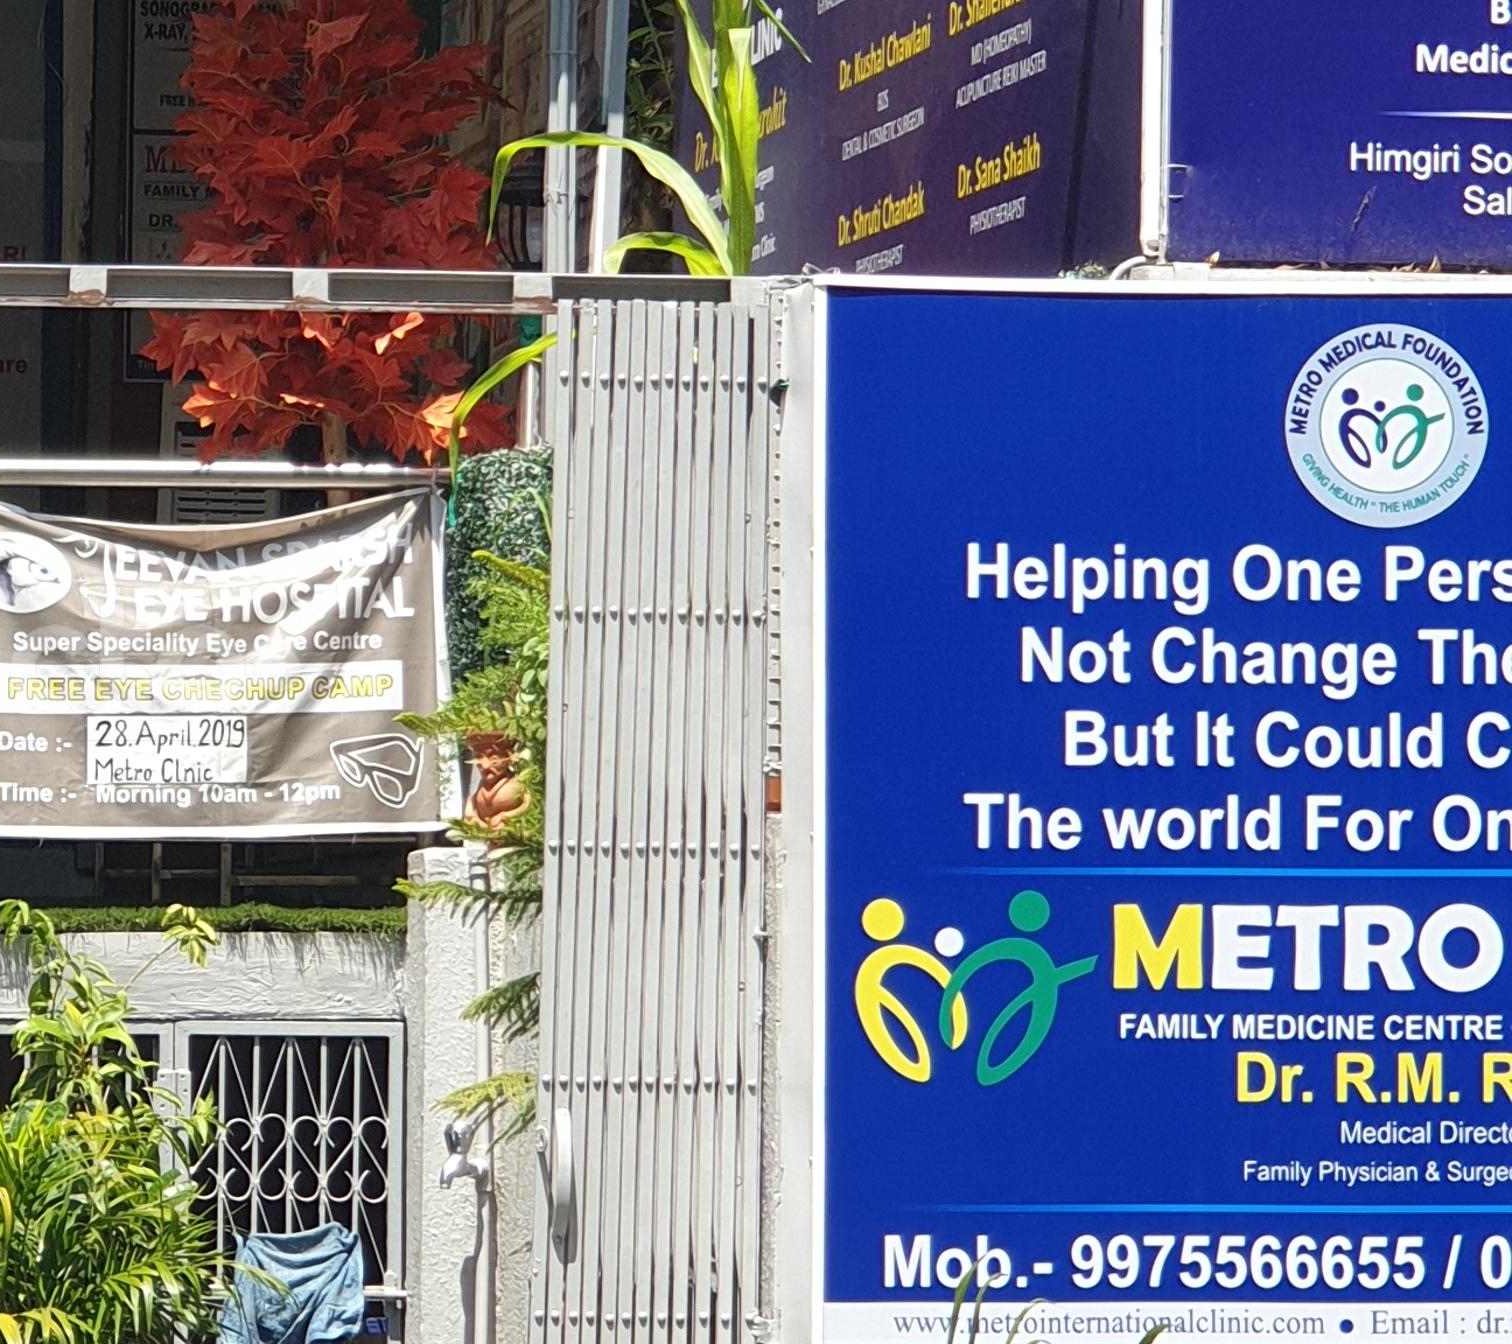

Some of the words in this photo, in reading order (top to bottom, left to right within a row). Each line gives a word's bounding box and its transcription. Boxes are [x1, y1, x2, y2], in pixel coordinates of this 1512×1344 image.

[1003, 132, 1041, 181] Shaikh
[1350, 141, 1460, 181] Himgiri
[1289, 370, 1323, 435] METRO
[1318, 331, 1398, 373] MEDICAL
[1401, 333, 1485, 436] FOUNDATION
[1302, 452, 1329, 487] GIVING
[1327, 478, 1369, 511] HEALTH
[1402, 485, 1442, 512] HUMAN
[967, 542, 1209, 616] Helping
[1232, 543, 1362, 602] One
[13, 633, 78, 654] Super
[87, 632, 198, 656] Speciality
[207, 632, 247, 654] Eye
[313, 630, 383, 652] Centre
[1021, 626, 1131, 684] Not
[1151, 626, 1397, 700] Change
[8, 678, 85, 701] FREE
[94, 677, 153, 701] EYE
[311, 673, 394, 701] CAMP
[1064, 710, 1175, 767] But
[1196, 710, 1235, 768] It
[1255, 710, 1443, 769] Could
[95, 757, 154, 783] Metro
[96, 783, 191, 808] Morning
[199, 783, 258, 803] 10am
[279, 782, 340, 806] 12pm
[963, 792, 1082, 850] The
[1102, 794, 1281, 851] world
[1306, 794, 1414, 852] For
[1112, 903, 1504, 993] METRO
[1120, 1013, 1225, 1040] FAMILY
[1232, 1014, 1375, 1041] MEDICINE
[1383, 1014, 1504, 1041] CENTRE
[1237, 1051, 1313, 1103] Dr.
[1336, 1051, 1460, 1104] R.M.
[1340, 1120, 1431, 1144] Medical
[1243, 1160, 1313, 1187] Family
[1318, 1160, 1419, 1187] Physician
[884, 1234, 1053, 1289] Mob.-
[1070, 1234, 1426, 1289] 9975566655
[1370, 1311, 1449, 1336] Email
